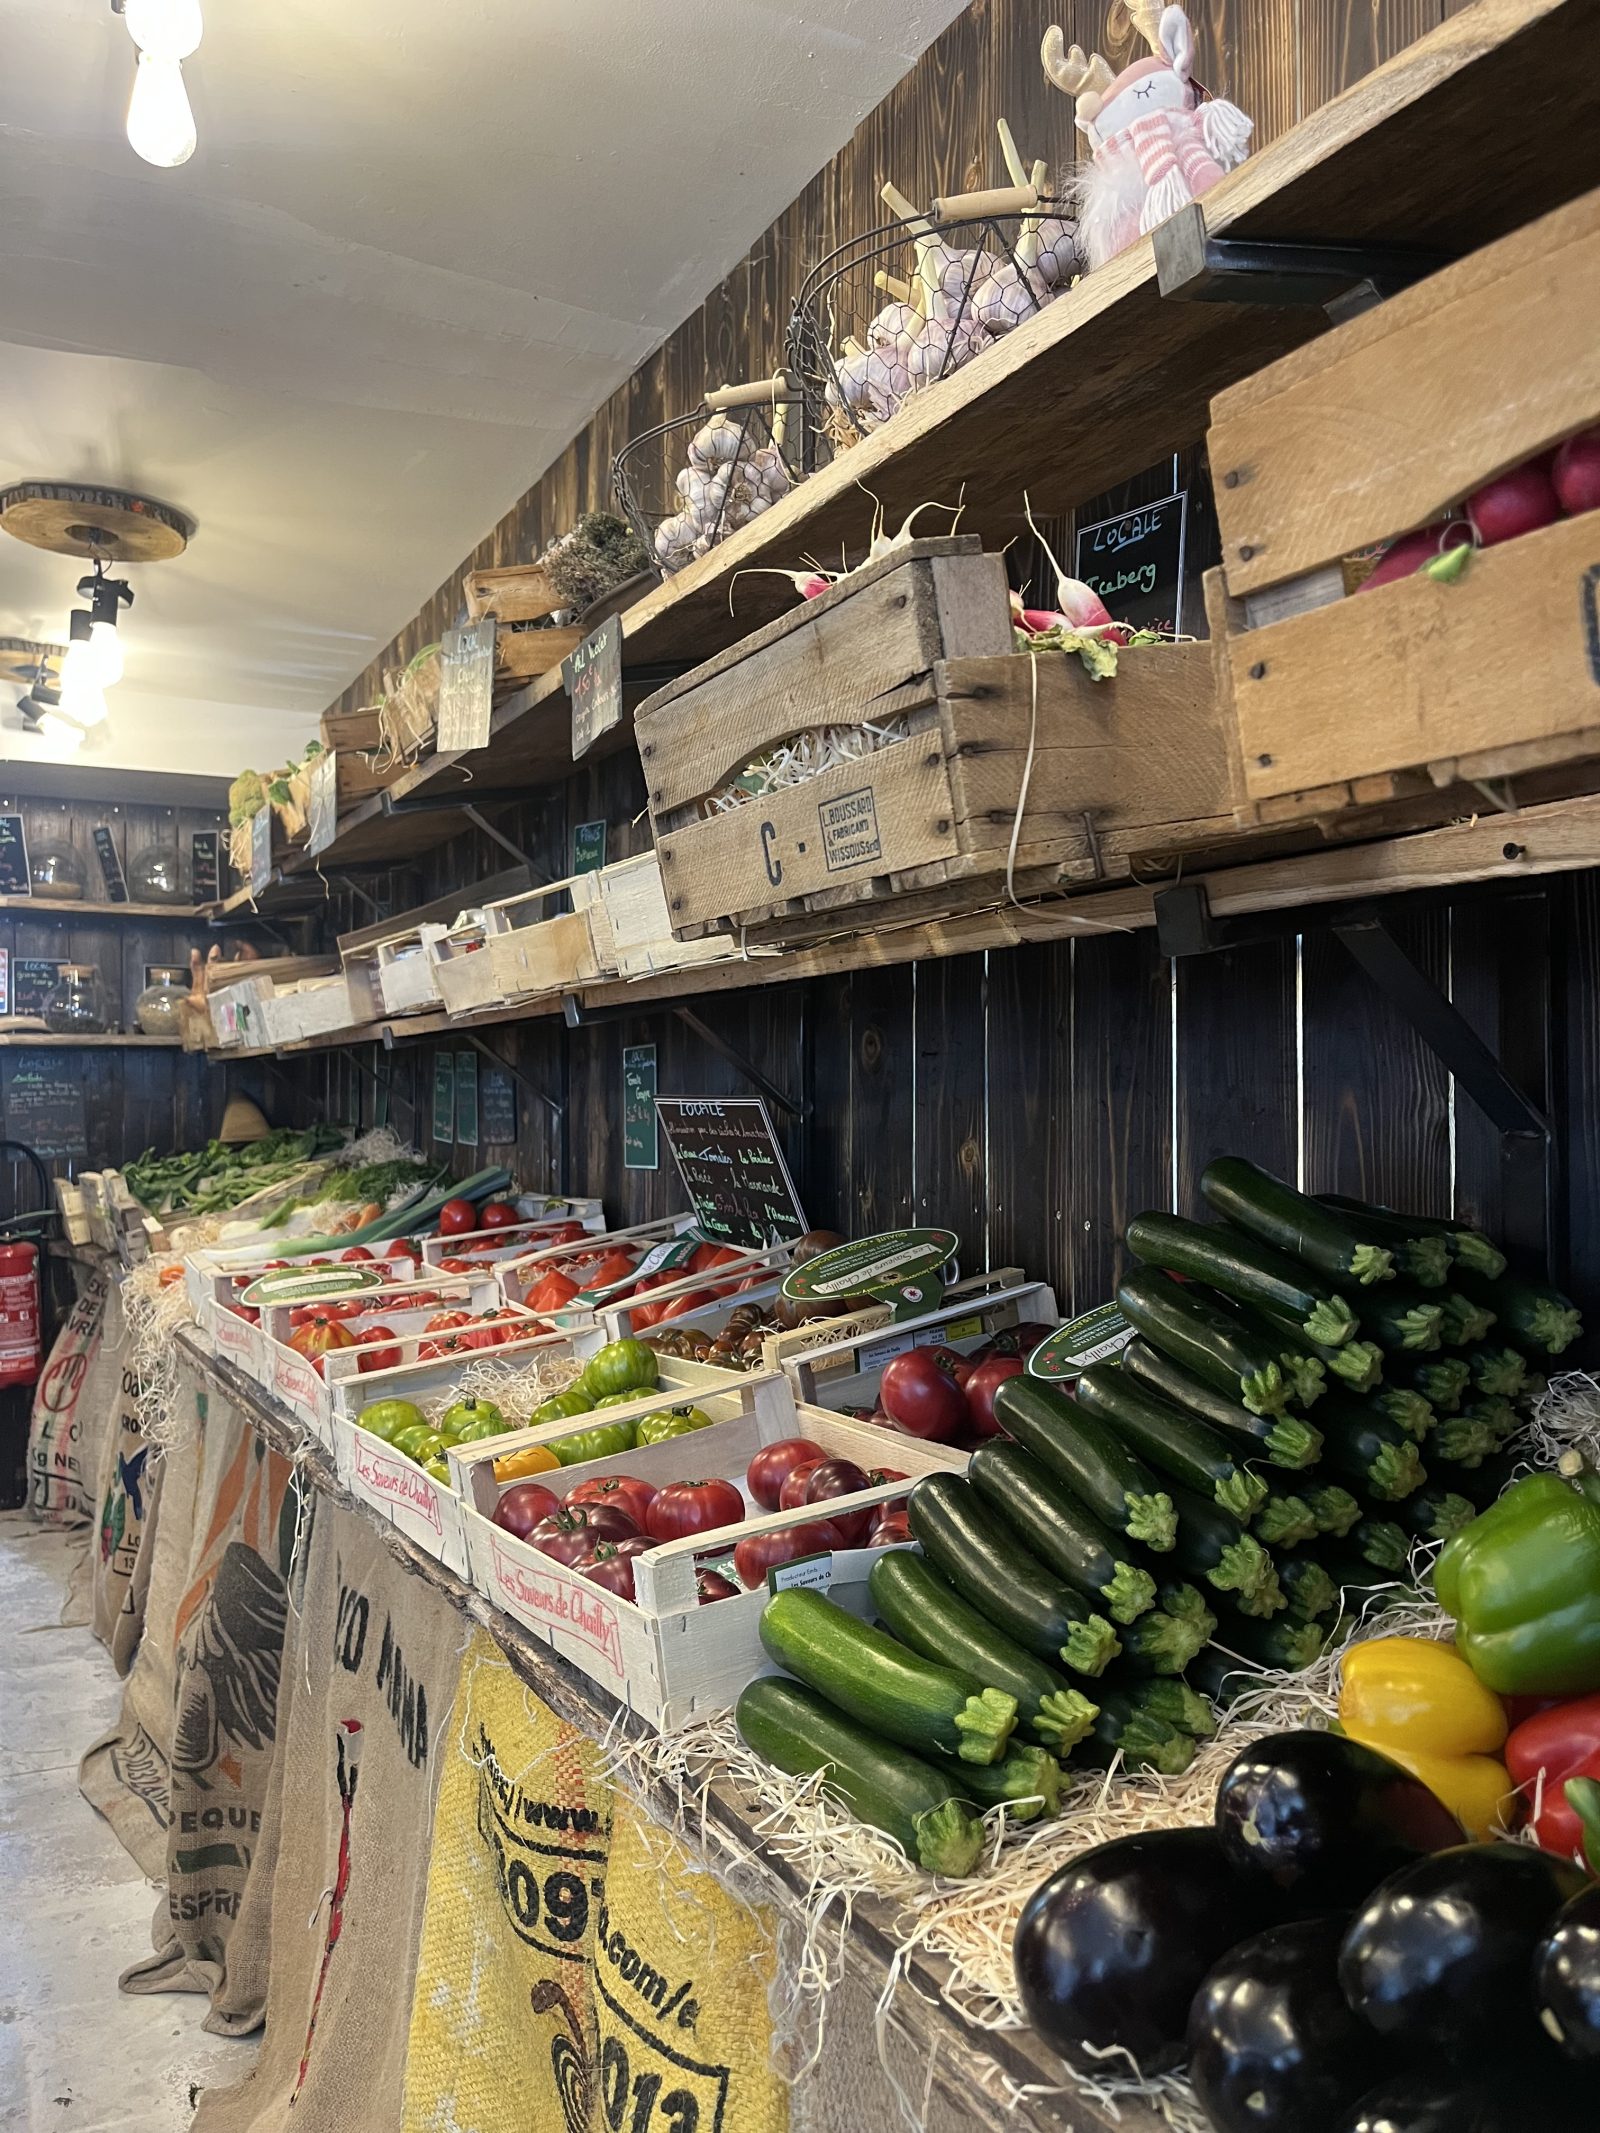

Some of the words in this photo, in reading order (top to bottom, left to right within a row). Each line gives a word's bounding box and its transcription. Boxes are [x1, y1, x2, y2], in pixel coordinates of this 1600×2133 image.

[1094, 506, 1168, 551] LOCALE
[680, 1100, 726, 1117] LOCALE
[912, 1245, 932, 1255] Les
[874, 1252, 912, 1271] Saveurs
[861, 1268, 873, 1277] de
[825, 1274, 859, 1292] Chailly
[1083, 1337, 1125, 1361] Chailly
[371, 1460, 398, 1492] Saveurs
[398, 1468, 408, 1496] de
[408, 1474, 434, 1519] Chailly
[799, 1577, 818, 1587] Saveurs
[514, 1569, 554, 1613] Saveurs
[555, 1583, 568, 1619] de
[570, 1588, 611, 1652] Chailly
